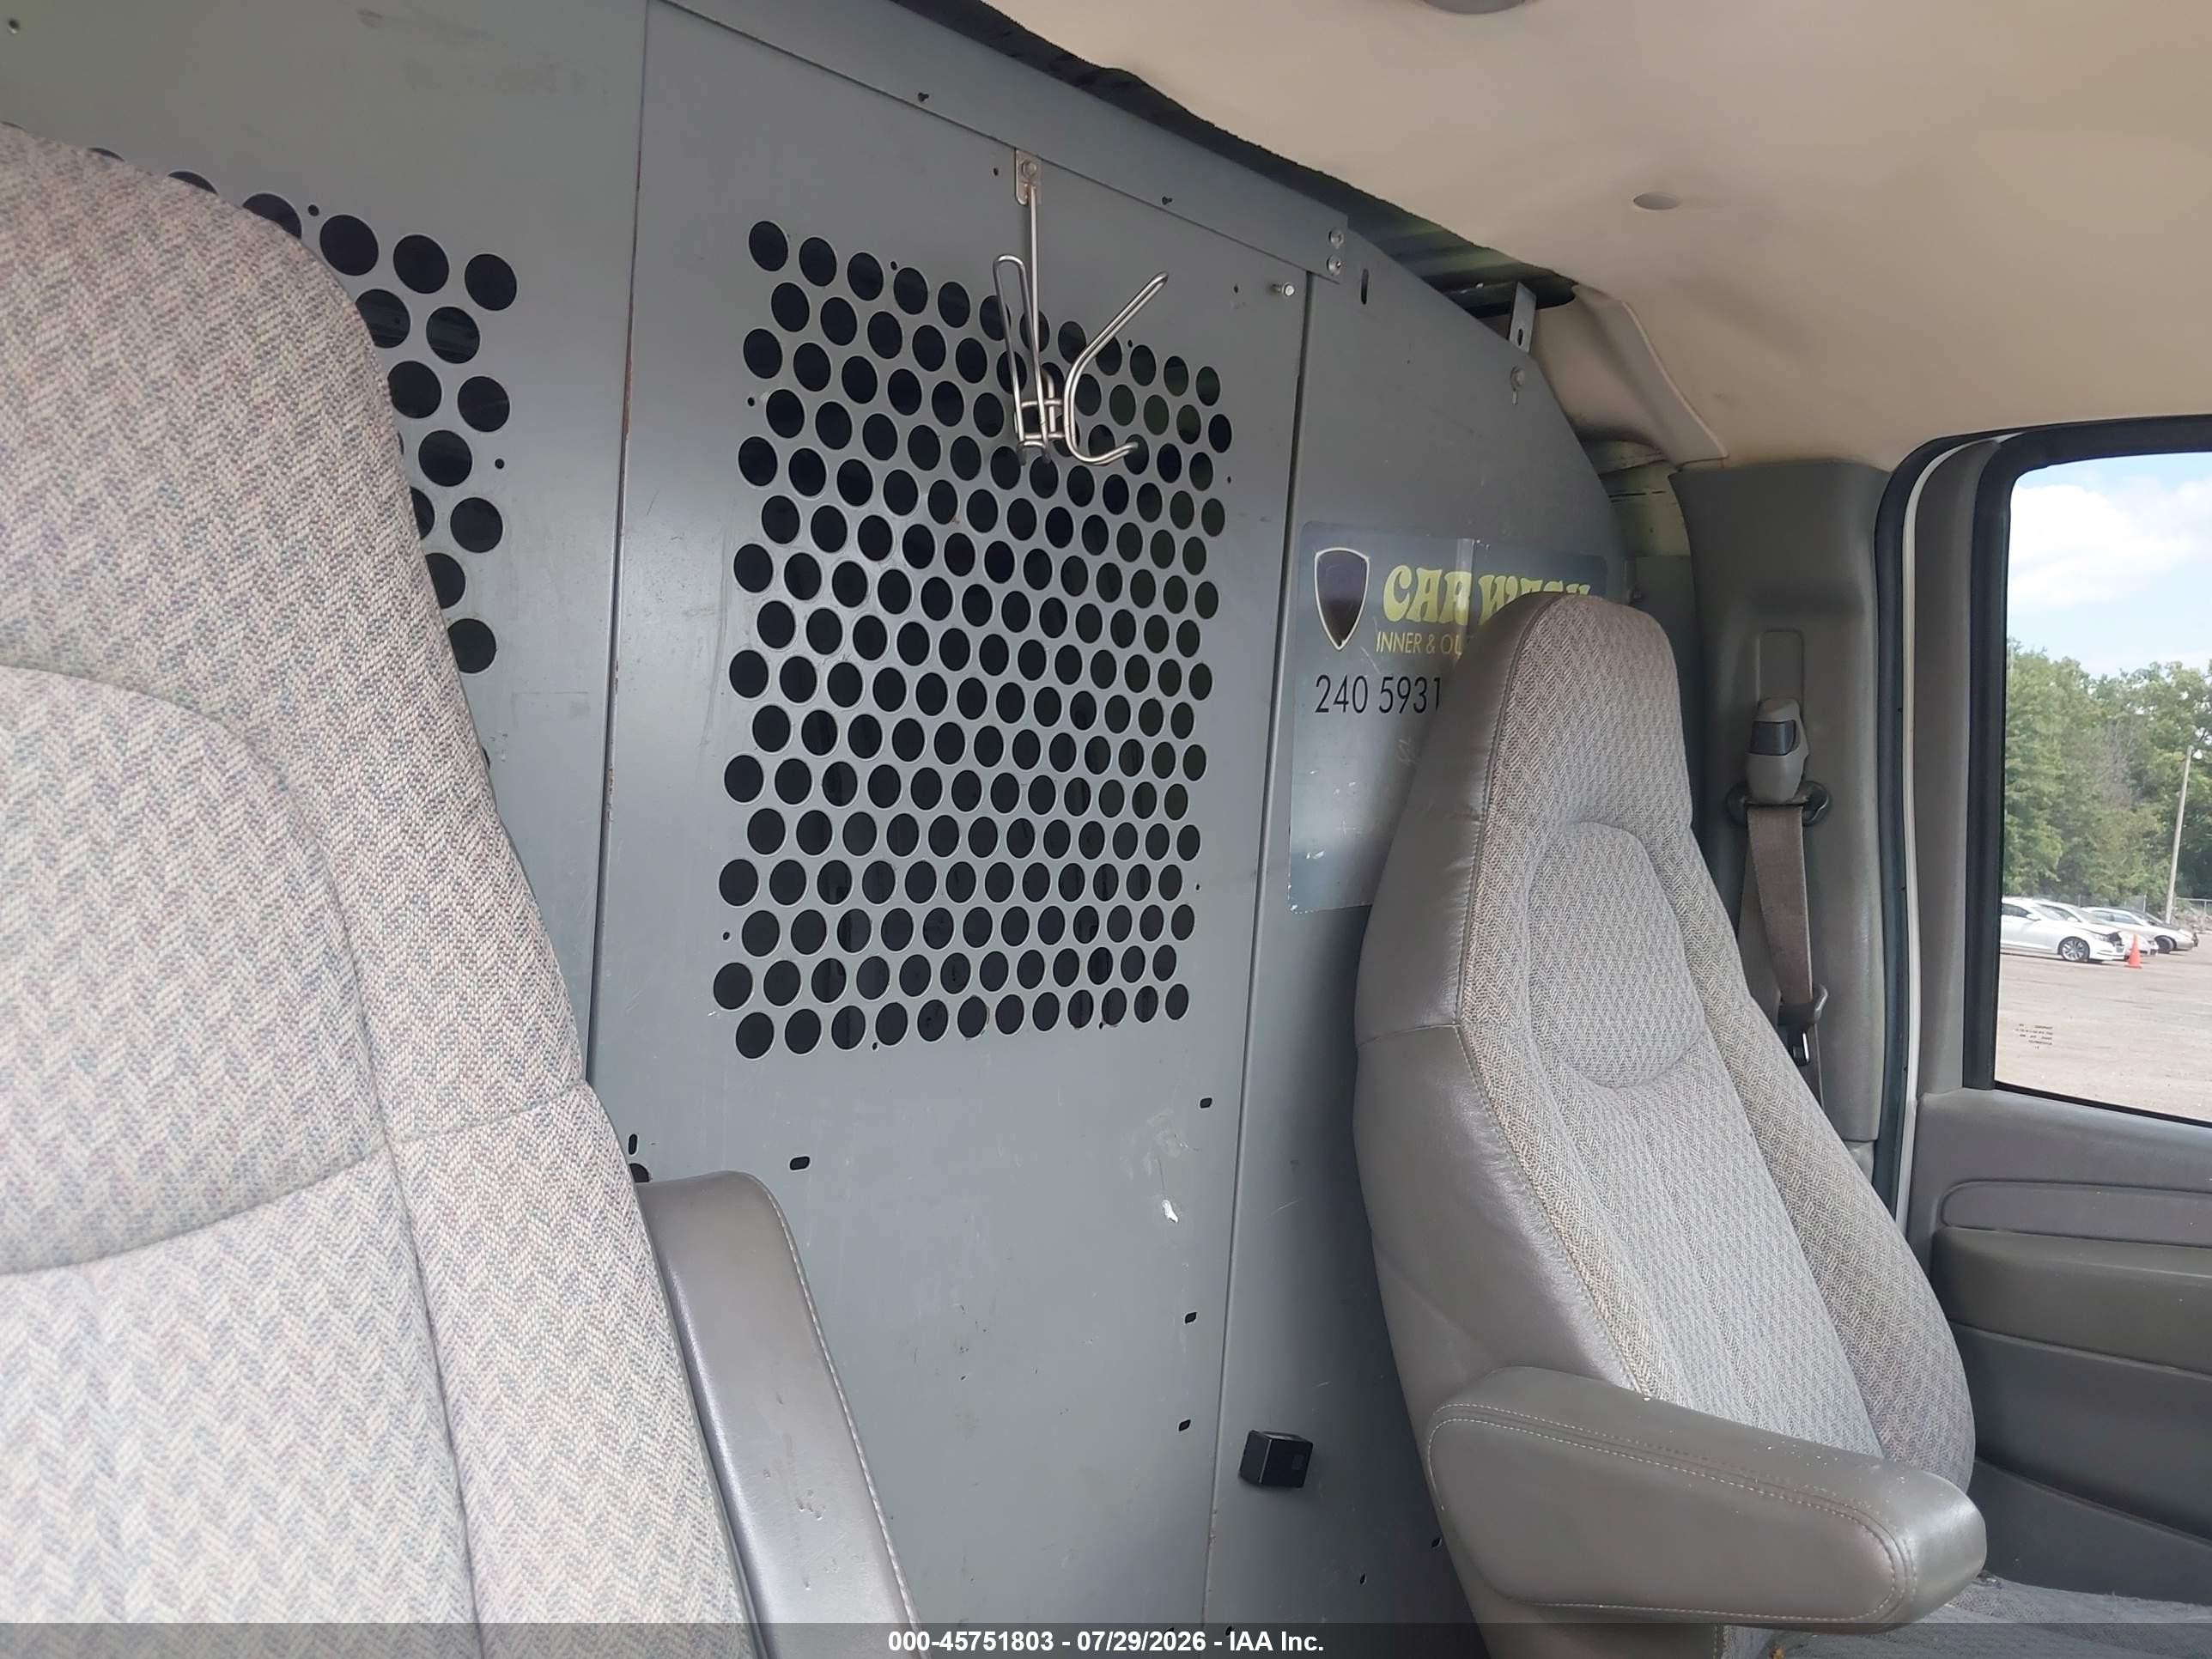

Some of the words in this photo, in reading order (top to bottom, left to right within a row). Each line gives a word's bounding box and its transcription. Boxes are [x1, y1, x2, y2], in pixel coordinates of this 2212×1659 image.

[1382, 564, 1473, 626] CAR
[1376, 630, 1423, 653] INNER
[1425, 633, 1436, 654] &
[1315, 674, 1369, 714] 240
[1378, 676, 1441, 714] 5931
